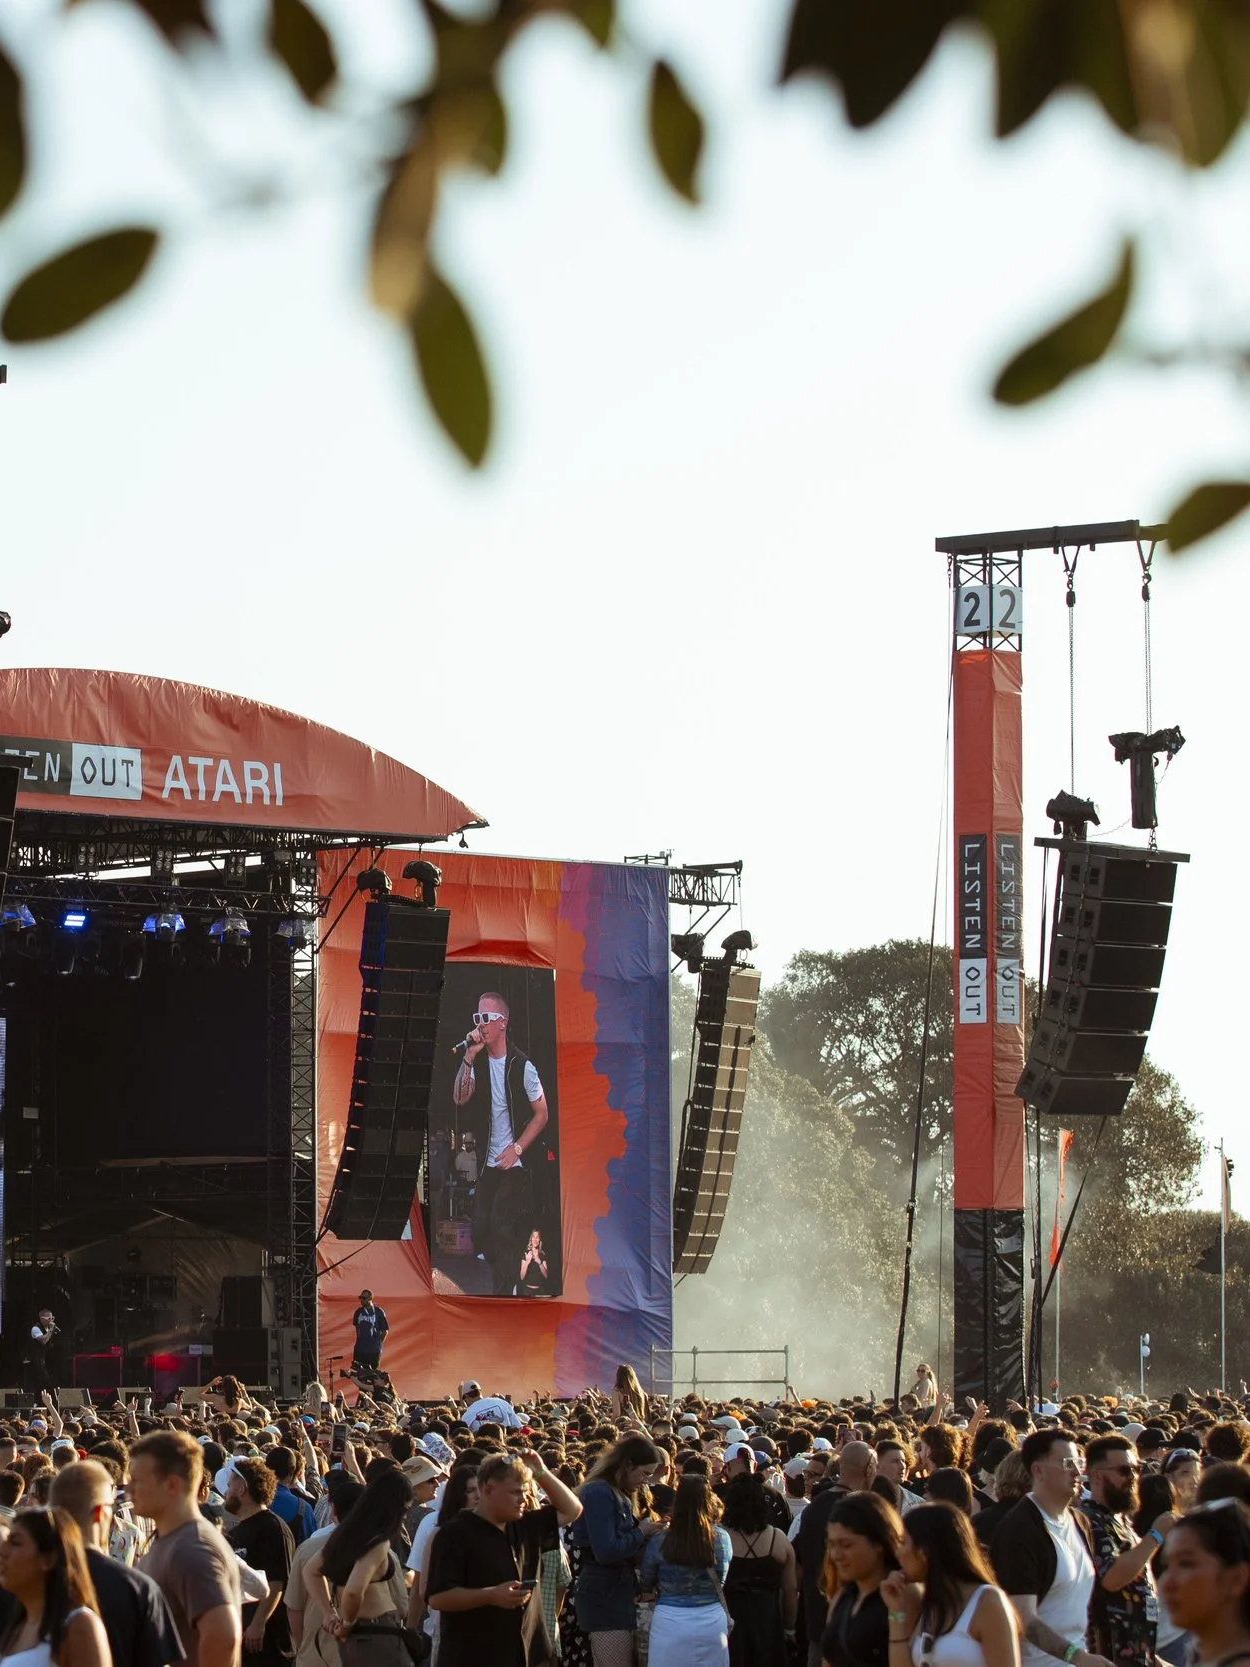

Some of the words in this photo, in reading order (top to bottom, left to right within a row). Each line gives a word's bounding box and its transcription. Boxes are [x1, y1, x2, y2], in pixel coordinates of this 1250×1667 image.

[964, 592, 980, 627] 2
[999, 588, 1016, 628] 2
[80, 756, 134, 788] OUT
[162, 755, 284, 806] ATARI
[964, 844, 981, 948] LISTEN
[1000, 844, 1015, 948] LISTEN
[965, 966, 981, 1016] OUT
[1002, 966, 1015, 1016] OUT
